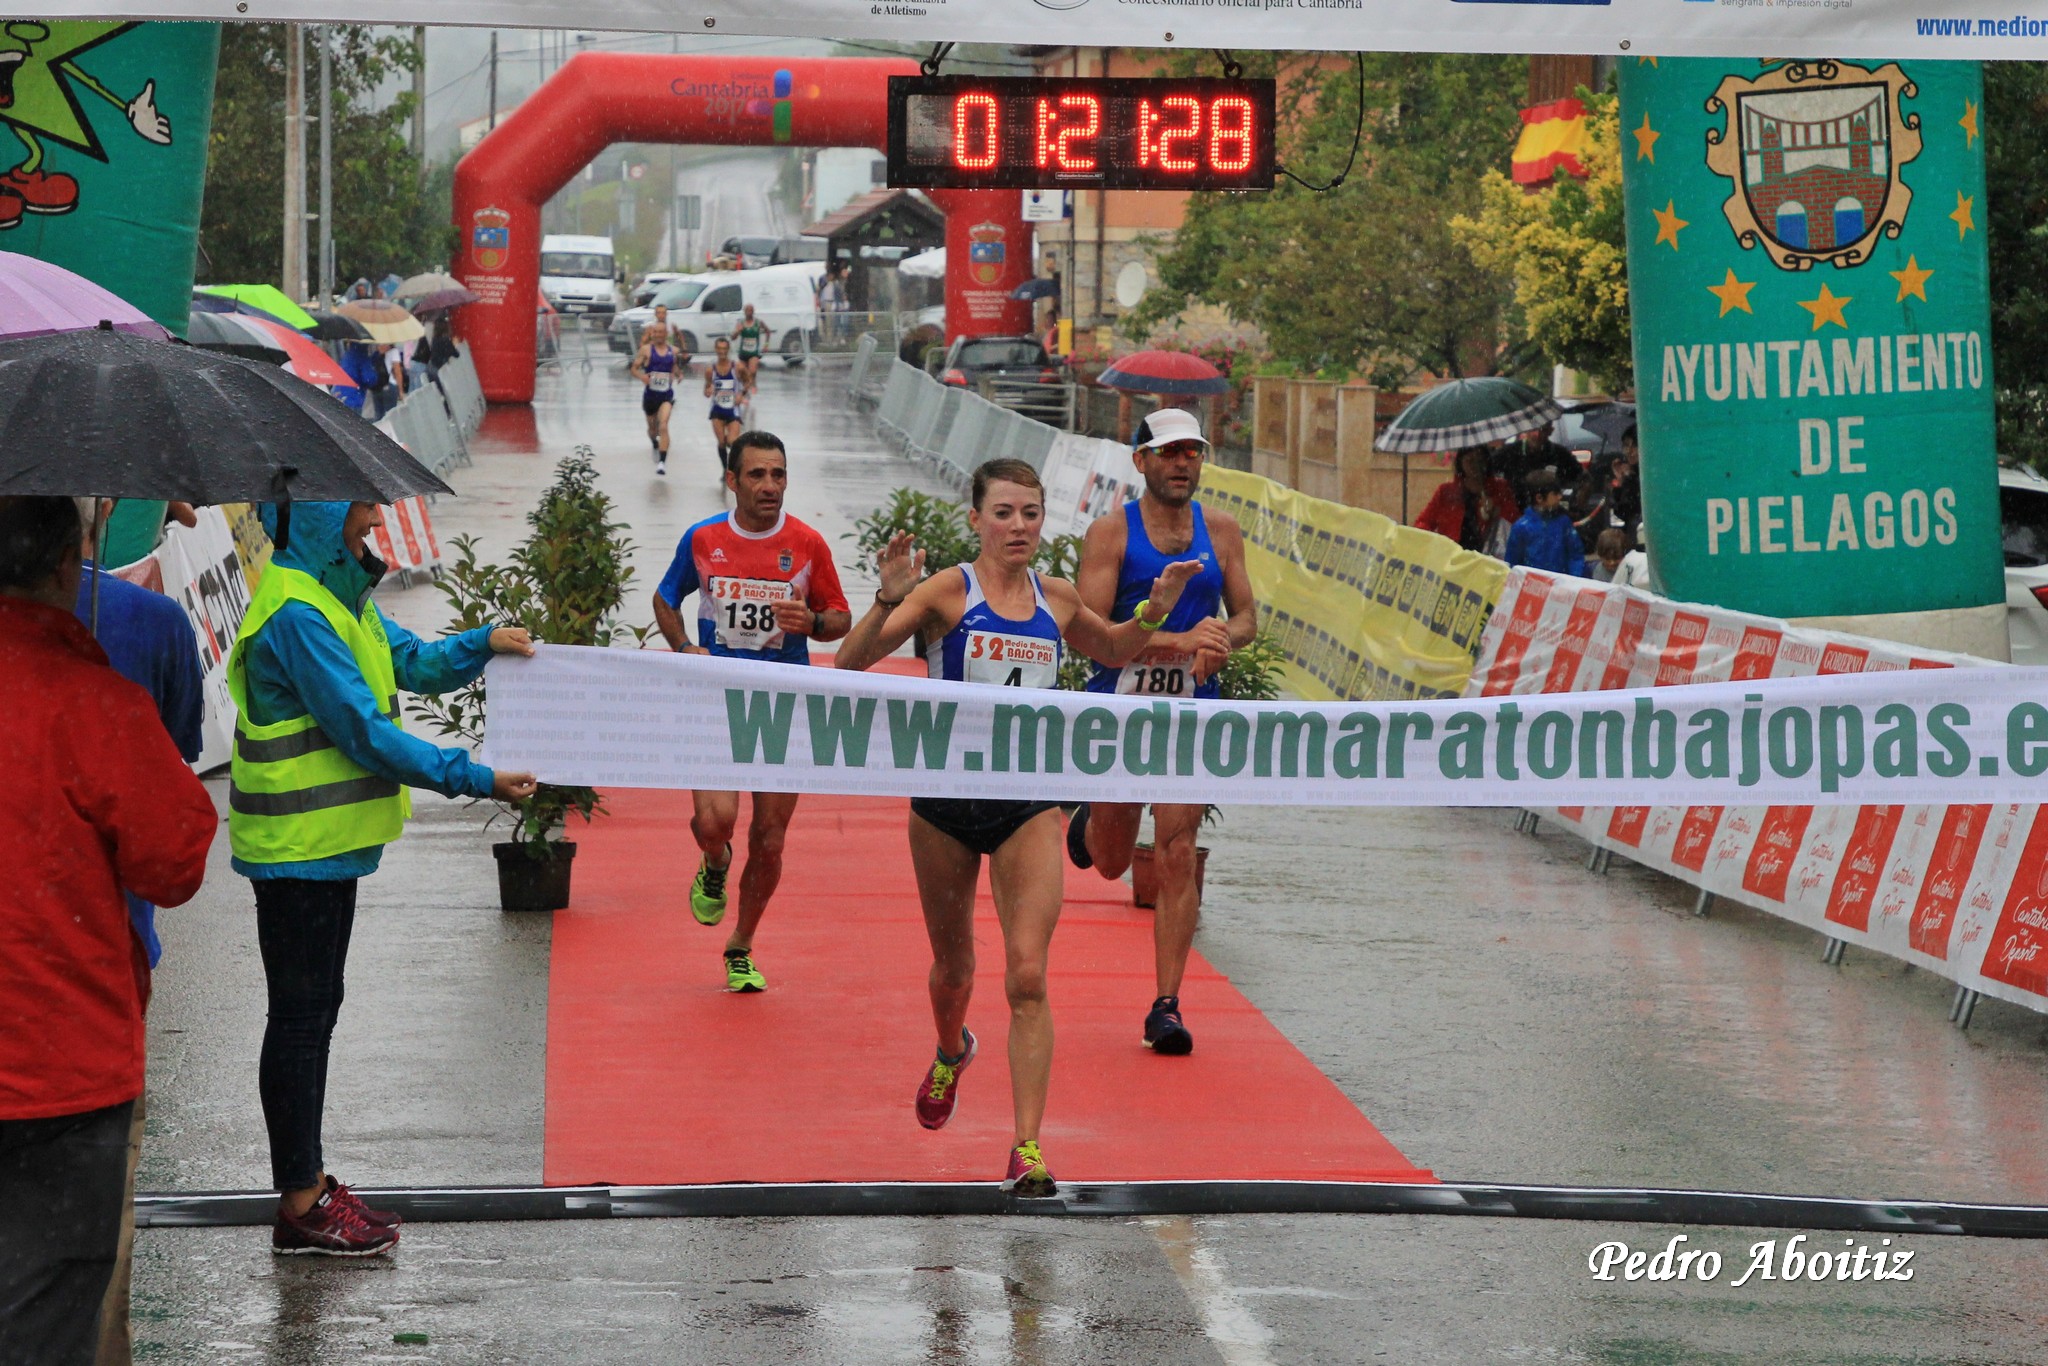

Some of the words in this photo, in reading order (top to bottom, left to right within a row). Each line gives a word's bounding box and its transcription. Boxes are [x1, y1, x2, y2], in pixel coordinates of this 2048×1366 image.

[871, 5, 882, 15] de
[884, 5, 927, 16] Atletismo
[1265, 0, 1293, 10] para
[1661, 330, 1984, 403] AYUNTAMIENTO
[1798, 415, 1867, 477] DE
[1707, 486, 1959, 556] PIELAGOS
[744, 589, 767, 598] BAJO
[769, 591, 785, 600] PAS
[725, 602, 776, 633] 138
[1008, 647, 1034, 660] BAJO
[1037, 651, 1053, 663] PAS
[1781, 641, 1820, 665] GOBIERNO
[1134, 667, 1184, 695] 180
[2000, 934, 2043, 976] Deporte
